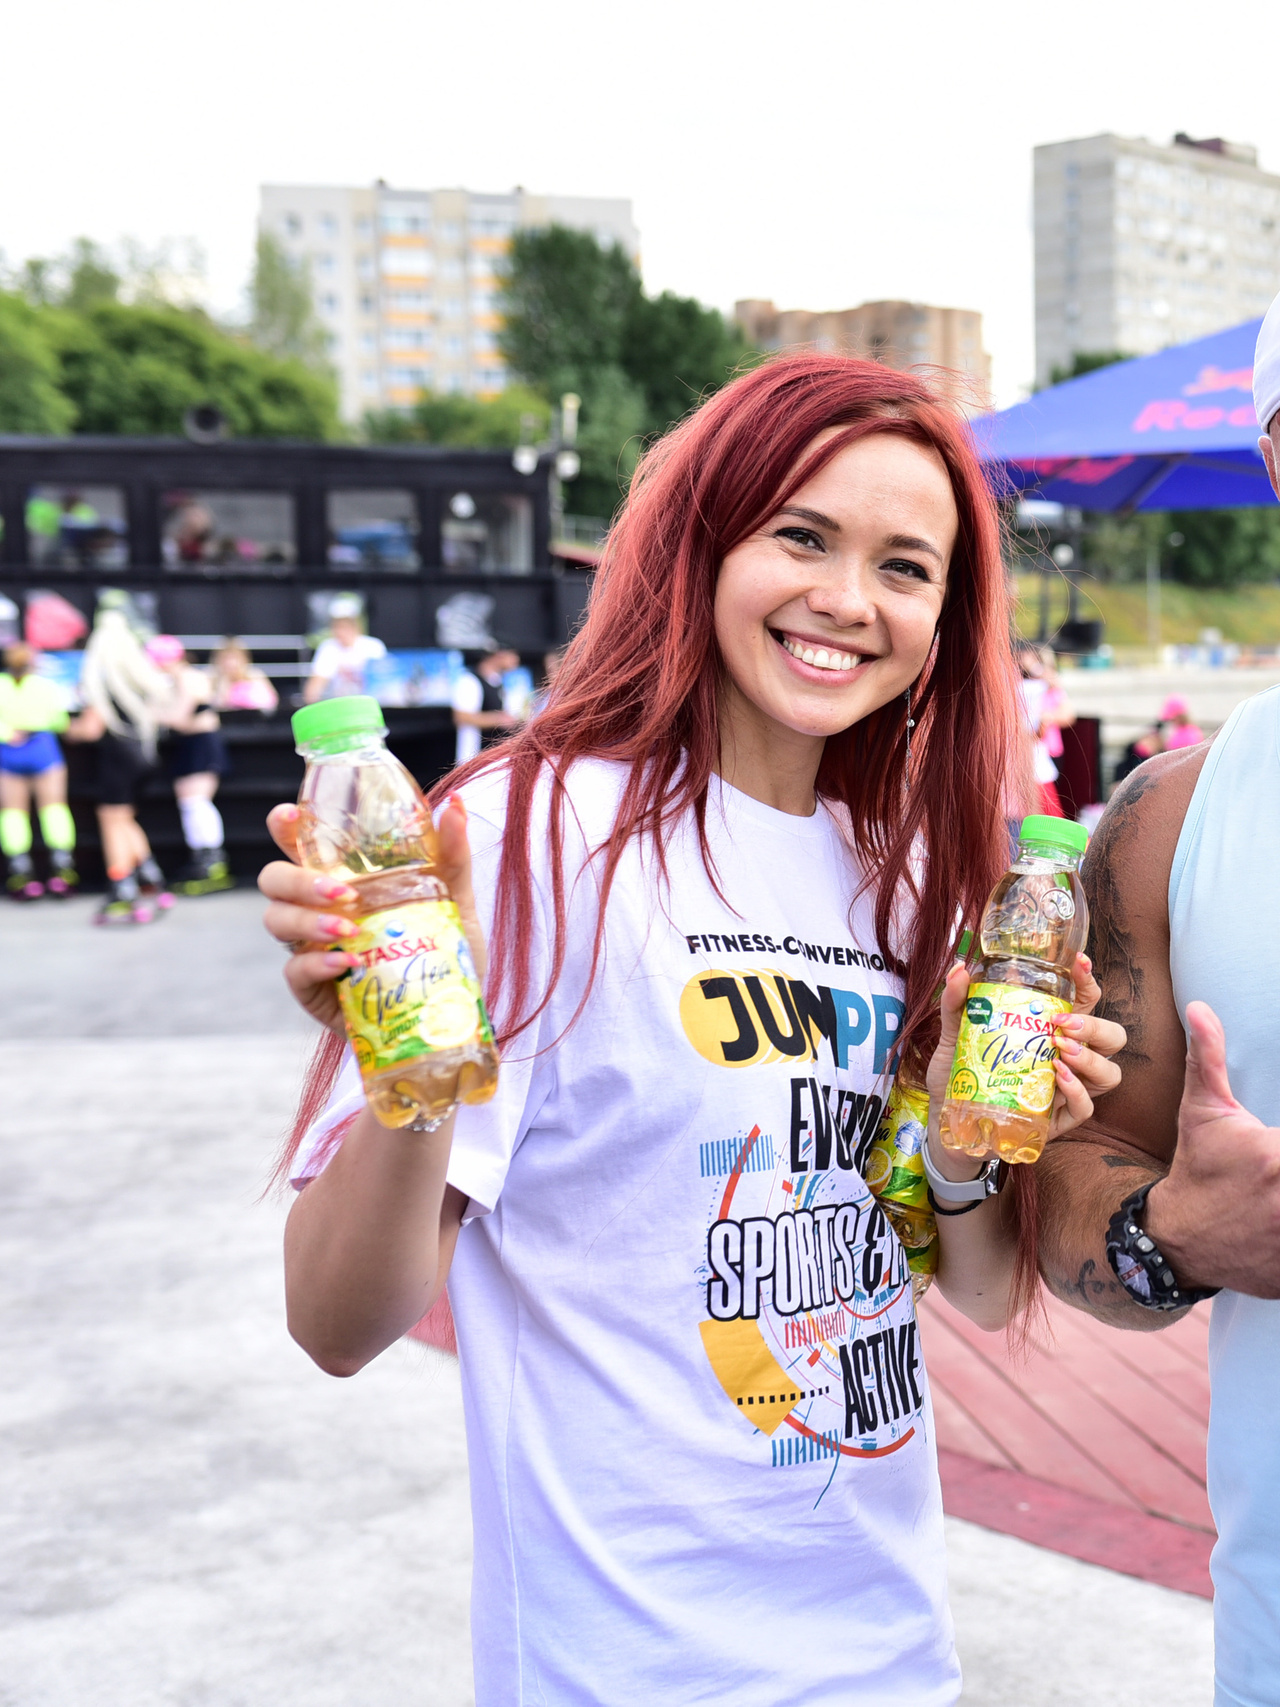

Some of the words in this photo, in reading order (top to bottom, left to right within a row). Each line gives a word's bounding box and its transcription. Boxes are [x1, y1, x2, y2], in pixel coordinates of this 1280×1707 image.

[361, 936, 438, 968] TASSAY
[699, 975, 906, 1075] JUMPR
[1003, 1012, 1058, 1037] TASSAY
[982, 1033, 1024, 1072] Ice
[1024, 1034, 1057, 1070] Tea
[987, 1075, 1023, 1088] Lemon
[707, 1202, 861, 1321] SPORTS
[862, 1199, 887, 1298] &
[839, 1320, 922, 1439] ACTIVE
